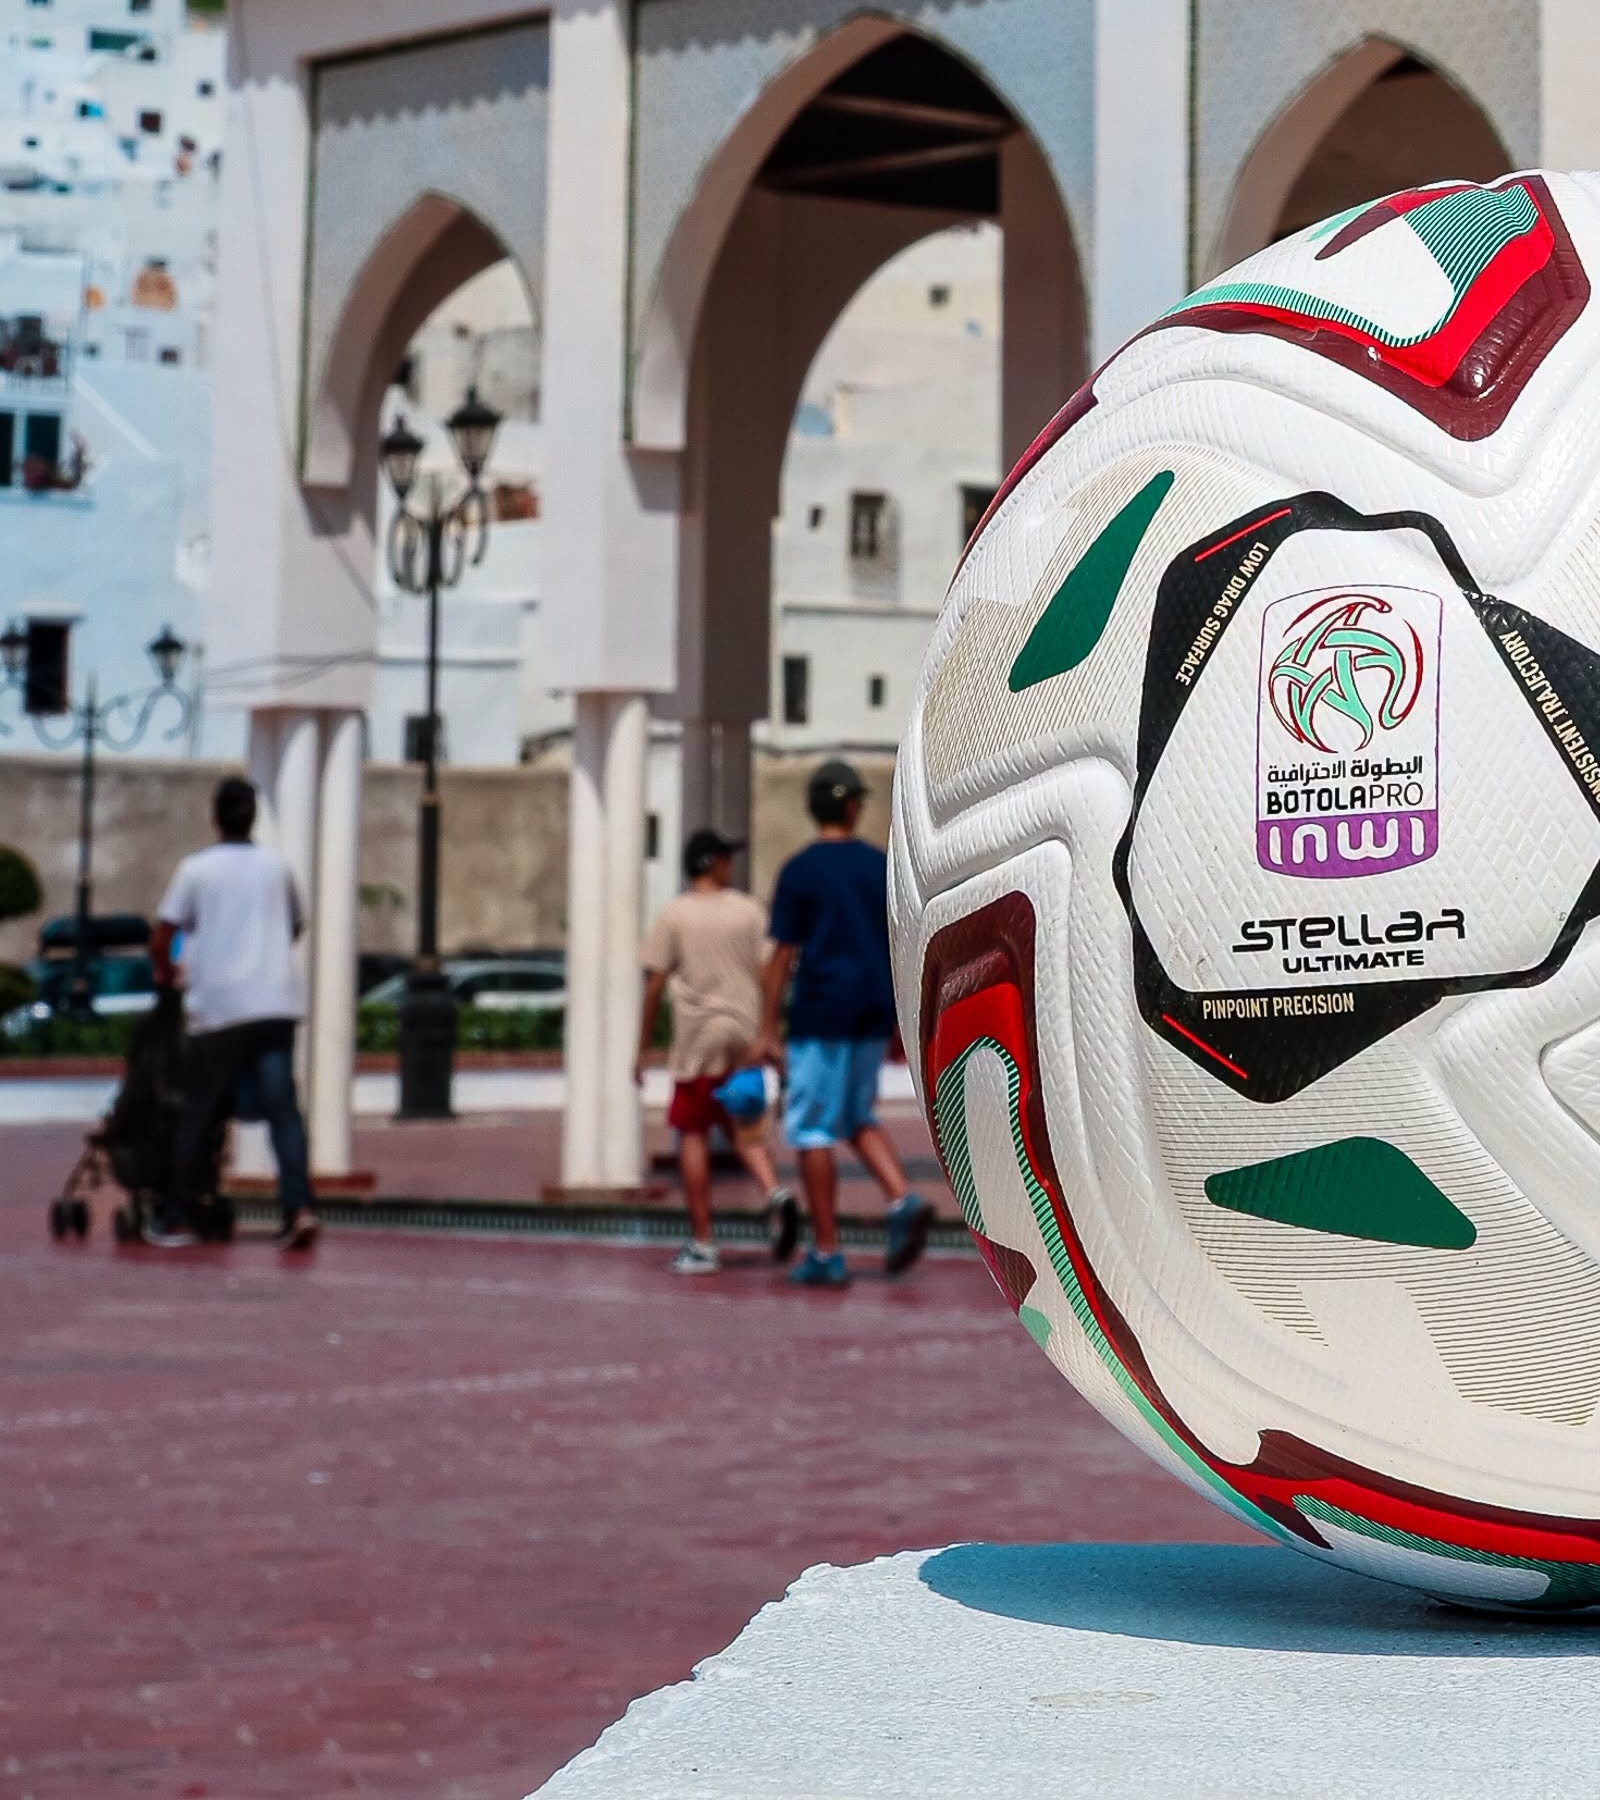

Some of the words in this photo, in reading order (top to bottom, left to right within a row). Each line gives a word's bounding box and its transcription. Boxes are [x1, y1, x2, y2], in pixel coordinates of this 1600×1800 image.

[1238, 541, 1270, 578] LOW
[1212, 575, 1247, 618] DRAG
[1174, 616, 1221, 687] SURFACE
[1498, 629, 1569, 724] TRAJECTORY
[1267, 760, 1346, 788] الاحترافية
[1350, 755, 1423, 782] البطولة
[1282, 949, 1425, 974] ULTIMATE
[1202, 996, 1269, 1020] PINPOINT
[1273, 992, 1355, 1017] PRECISION
